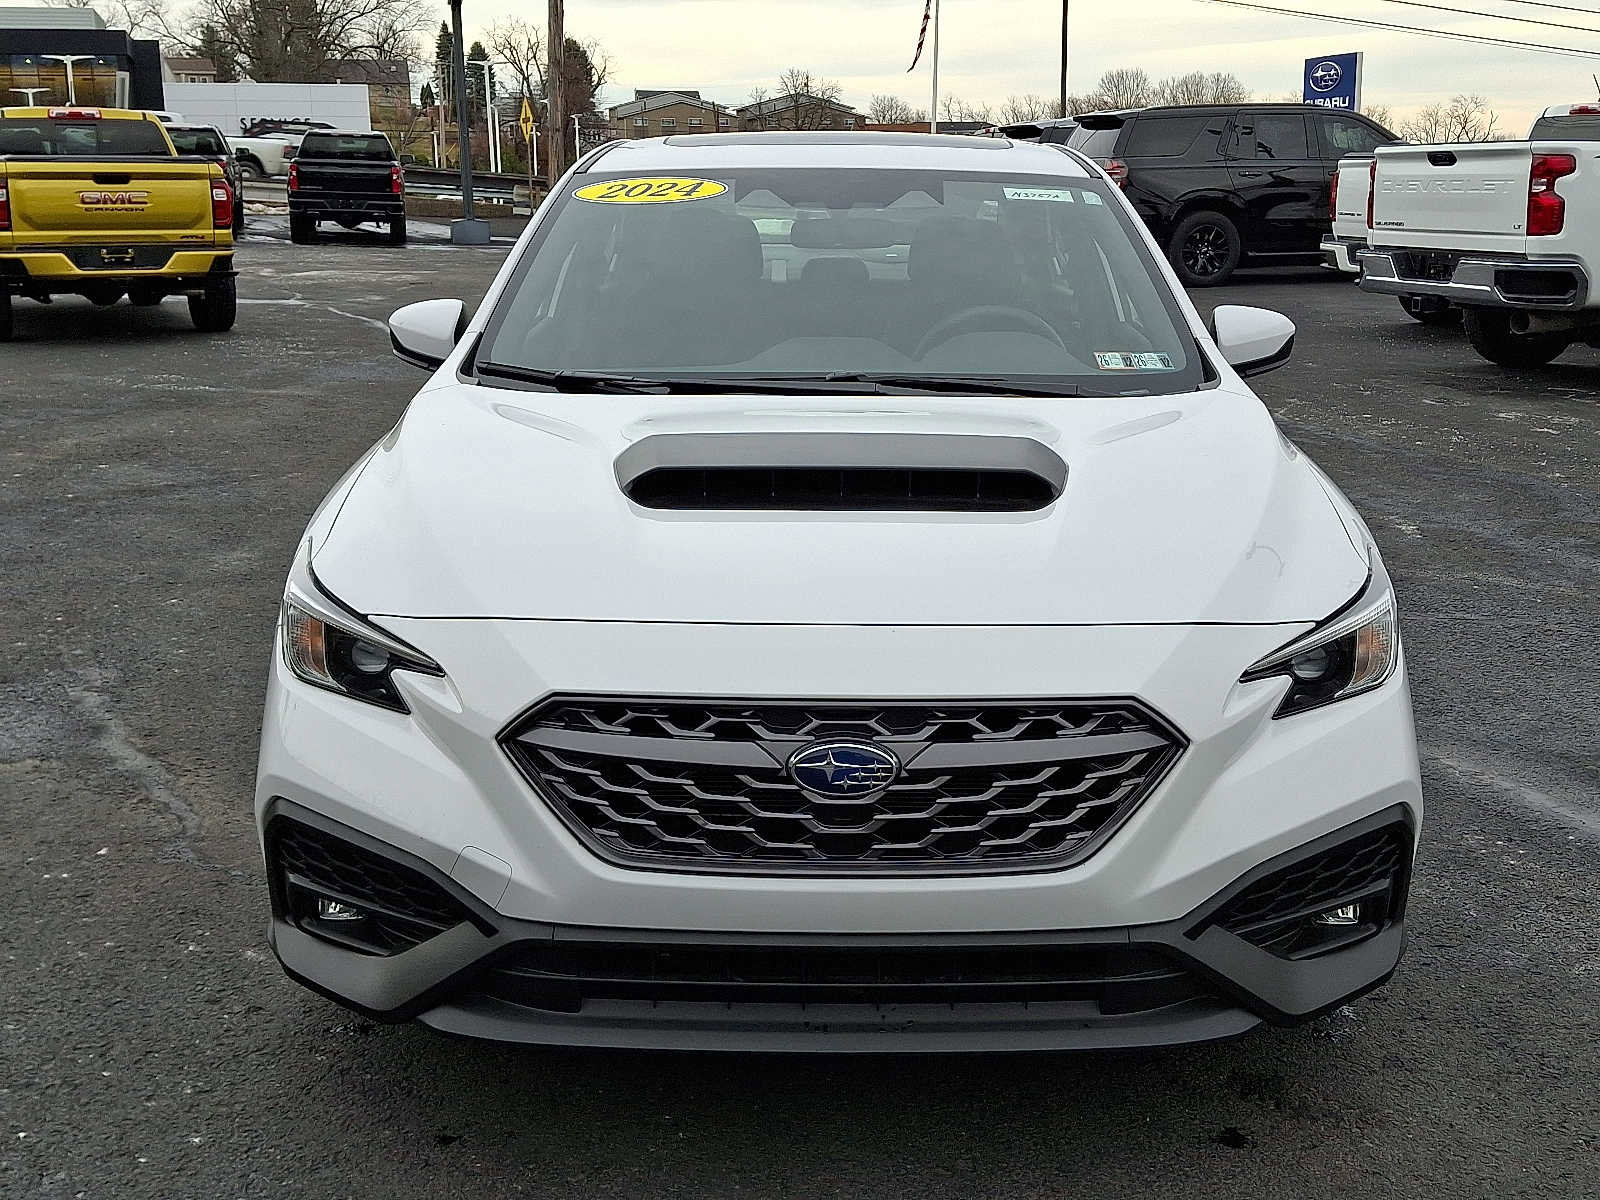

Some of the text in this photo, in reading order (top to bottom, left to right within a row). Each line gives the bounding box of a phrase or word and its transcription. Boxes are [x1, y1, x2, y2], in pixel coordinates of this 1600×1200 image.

[598, 182, 704, 198] 2024
[1381, 179, 1515, 194] CHEVROLET
[79, 191, 149, 205] GMC
[1097, 354, 1110, 366] 26
[1134, 354, 1147, 367] 26
